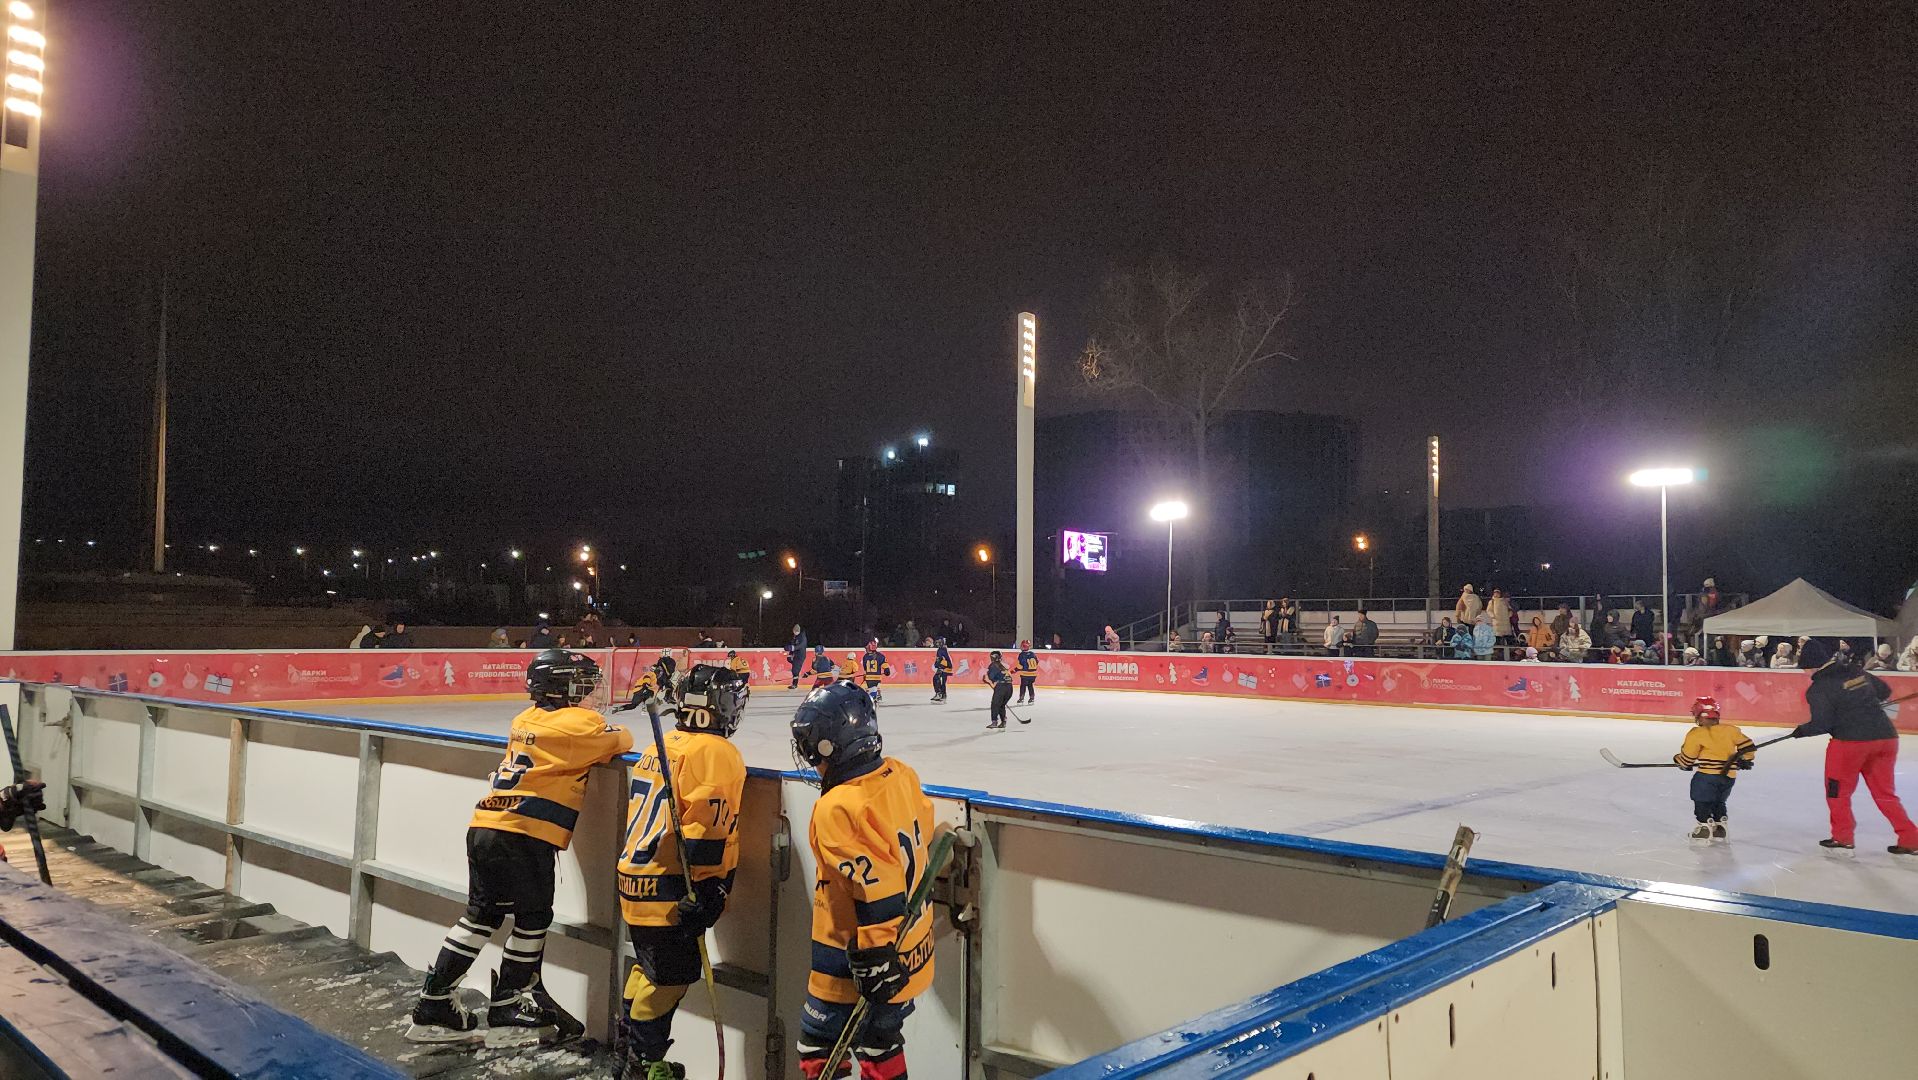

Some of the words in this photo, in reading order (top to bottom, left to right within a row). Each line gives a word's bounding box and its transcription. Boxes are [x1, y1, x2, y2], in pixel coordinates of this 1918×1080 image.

[866, 660, 878, 673] 13
[1097, 661, 1139, 675] ЗИМА
[1616, 679, 1666, 688] КАТАЙТЕСЬ
[1601, 687, 1608, 695] С
[681, 707, 711, 728] 70
[708, 798, 730, 827] 70
[839, 855, 885, 886] 22
